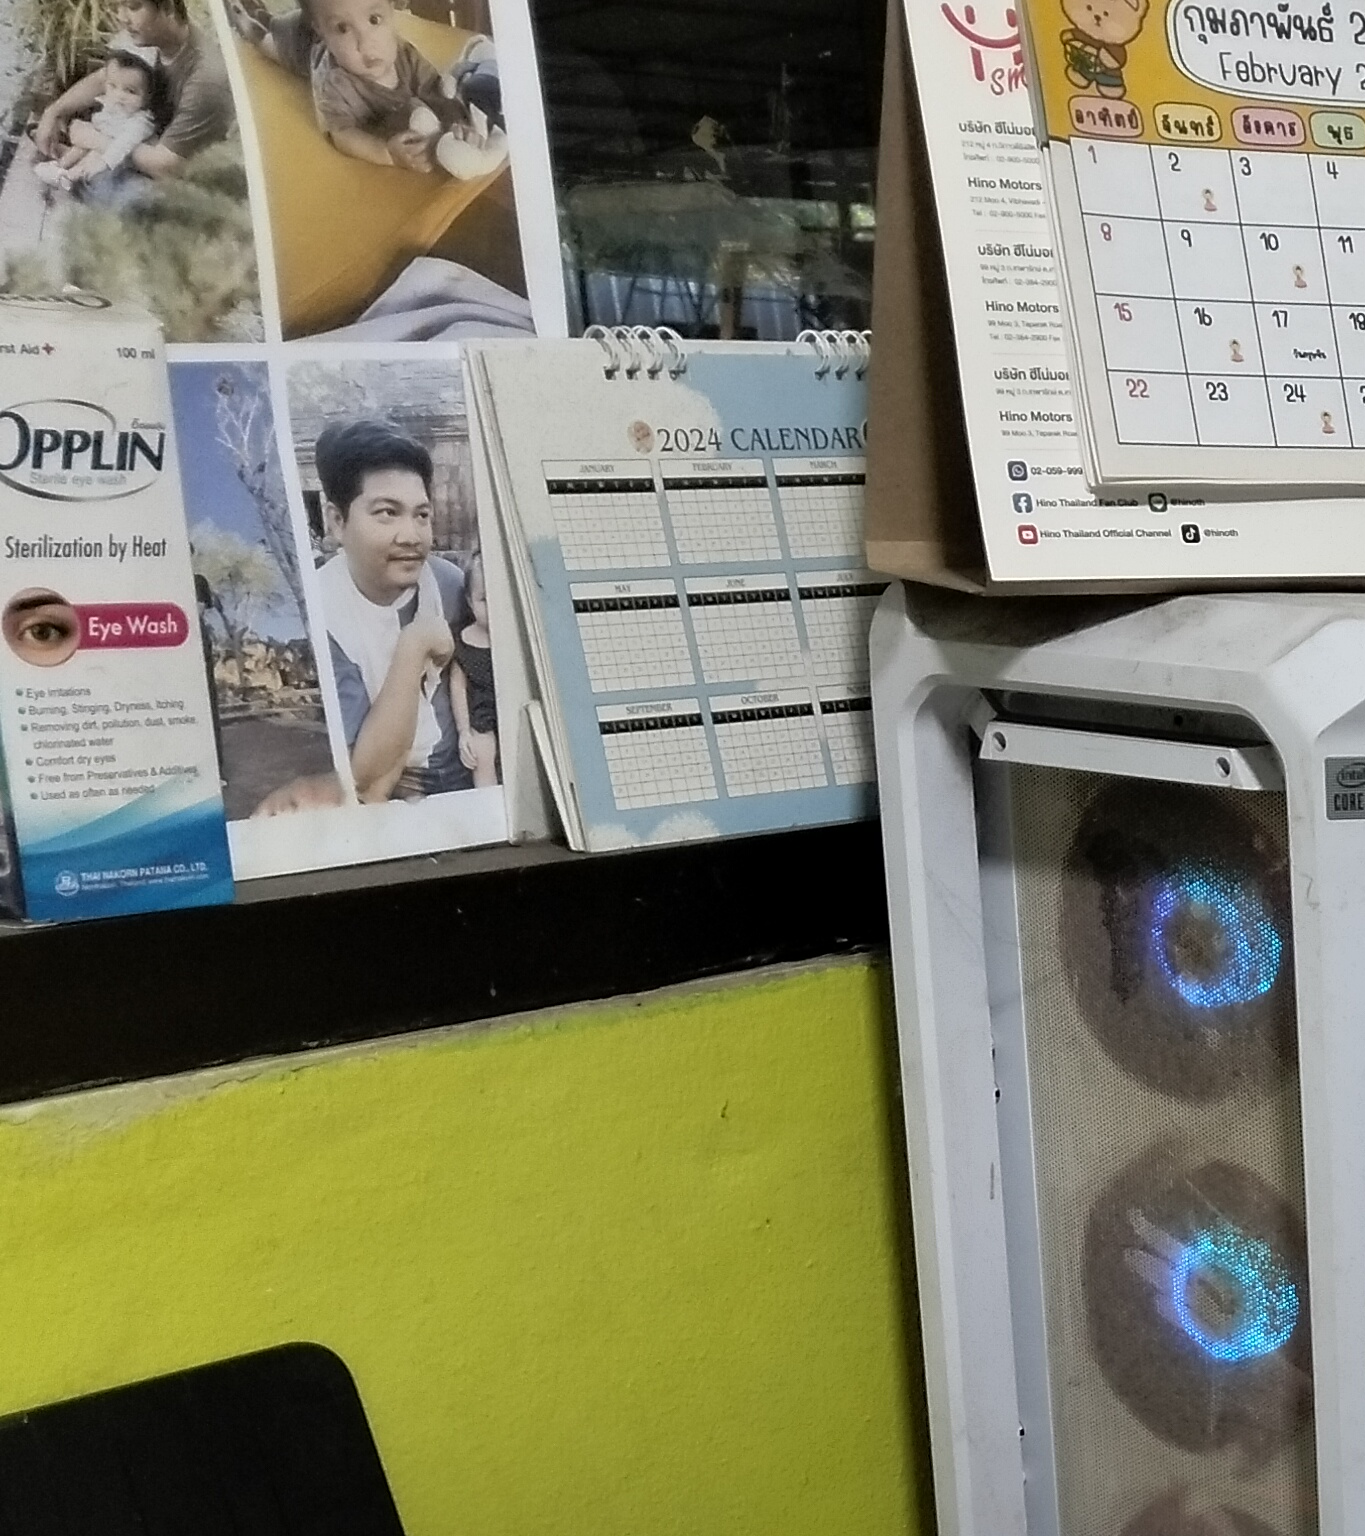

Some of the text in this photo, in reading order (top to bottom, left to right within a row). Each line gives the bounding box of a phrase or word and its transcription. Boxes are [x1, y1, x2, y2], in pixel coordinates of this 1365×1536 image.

[1183, 2, 1335, 45] กุมภาพันธ์
[1219, 51, 1342, 96] February
[959, 121, 992, 134] บริษัท
[1075, 107, 1139, 130] อาทิตย์
[1162, 114, 1214, 137] จันทร์
[1242, 114, 1297, 137] อังคาร
[1327, 125, 1354, 145] พุธ
[1088, 145, 1097, 164] 1
[1168, 153, 1181, 172] 2
[1239, 157, 1252, 176] 3
[1327, 161, 1339, 179] 4
[967, 177, 1043, 190] Hino Motors
[1100, 223, 1112, 241] 8
[1181, 229, 1193, 247] 9
[1260, 233, 1280, 251] 10
[1338, 235, 1354, 253] 11
[978, 243, 1010, 256] บริษัท
[986, 301, 1059, 314] Hino Motors
[1114, 302, 1132, 322] 15
[1194, 307, 1213, 326] 16
[1272, 310, 1288, 328] 17
[20, 343, 39, 355] Aid
[116, 347, 155, 359] 100 ml
[994, 367, 1026, 380] บริษัท
[1126, 378, 1150, 398] 22
[1206, 382, 1228, 401] 23
[1283, 384, 1306, 403] 24
[999, 411, 1073, 423] Hino Motors
[0, 411, 166, 471] OPPLIN
[657, 426, 863, 453] 2024 CALENDAR
[72, 474, 92, 487] eye
[1036, 498, 1057, 508] Hino
[1060, 498, 1096, 508] Thailand
[1040, 529, 1171, 539] Hino Thailand Official Channel
[5, 533, 167, 563] Sterilization by Heat
[88, 613, 178, 641] Eye Wash
